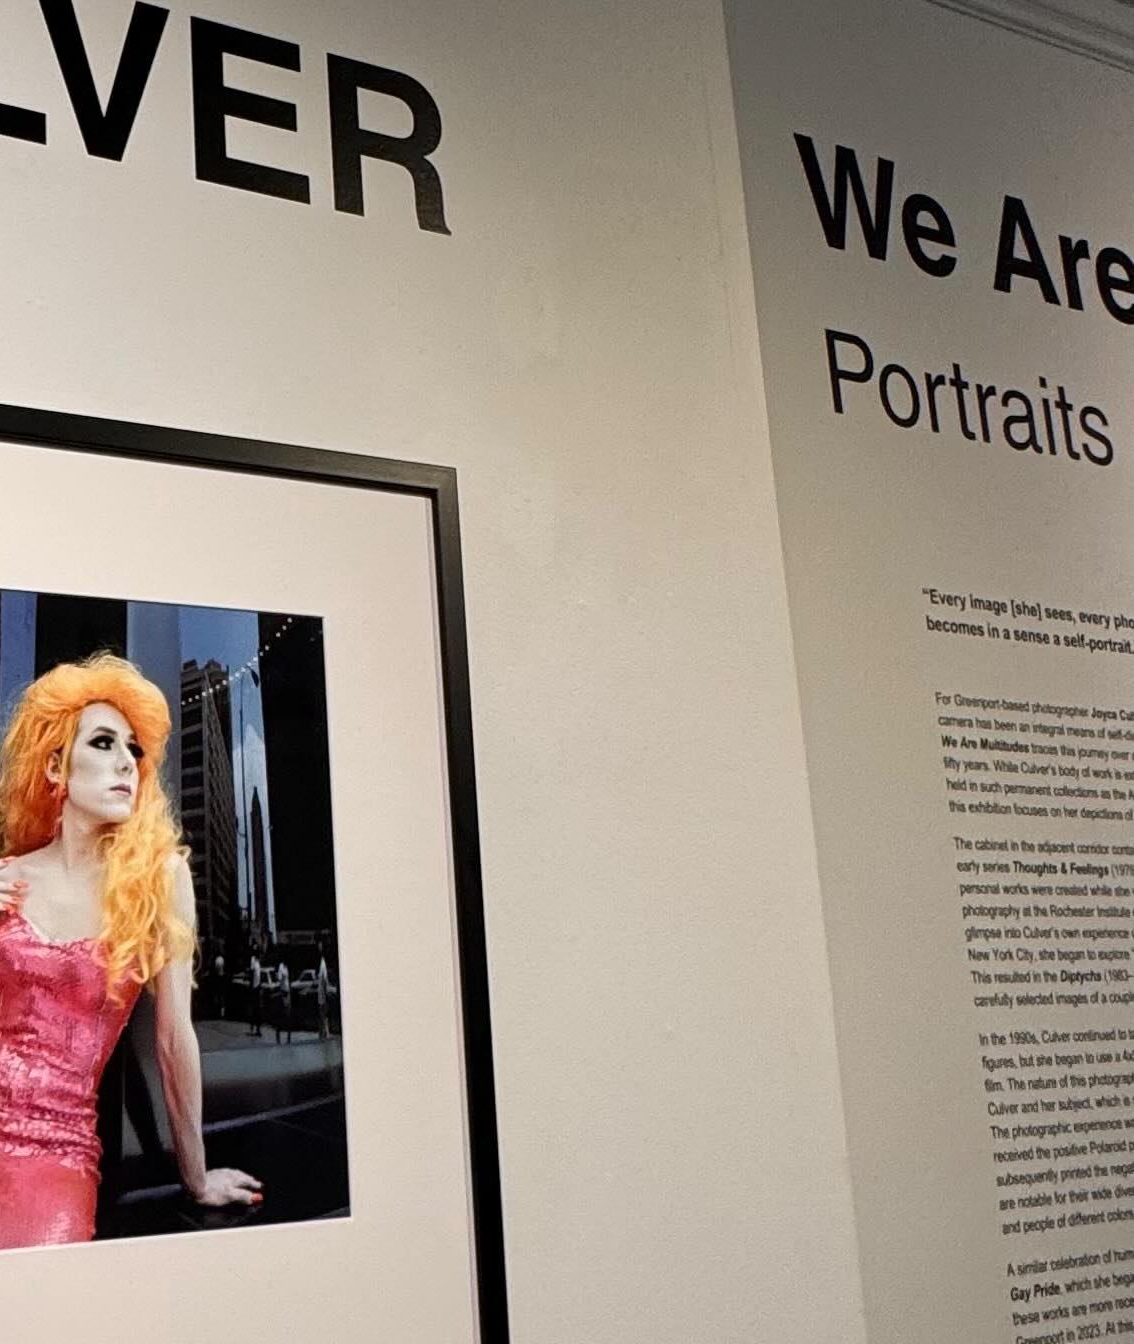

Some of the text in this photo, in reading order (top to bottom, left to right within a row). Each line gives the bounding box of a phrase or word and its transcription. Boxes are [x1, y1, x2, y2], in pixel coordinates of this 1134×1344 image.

[794, 132, 1134, 326] We Are
[824, 328, 1114, 467] Portraits
[970, 593, 1008, 616] image
[1010, 599, 1042, 621] [she]
[1044, 607, 1076, 625] sees,
[1079, 611, 1110, 630] every
[925, 615, 984, 637] becomes
[987, 623, 999, 638] in
[1003, 628, 1010, 640] a
[1013, 629, 1051, 645] sense
[1053, 634, 1061, 646] a
[935, 691, 951, 705] For
[1091, 707, 1117, 722] Joyce
[938, 716, 1105, 739] camera has been an integral means of
[941, 735, 958, 748] We
[960, 736, 977, 749] Are
[980, 737, 1030, 753] Multitudes
[1058, 764, 1080, 781] body
[1081, 765, 1090, 778] of
[1092, 767, 1112, 779] work
[945, 777, 1126, 800] held in such permanent collections as the
[968, 801, 1011, 815] exhibition
[1013, 802, 1048, 817] focuses
[1050, 807, 1061, 818] on
[1063, 805, 1078, 818] her
[953, 836, 972, 850] The
[975, 838, 1009, 851] cabinet
[1011, 841, 1019, 852] in
[1021, 840, 1035, 853] the
[1038, 840, 1075, 856] adjacent
[956, 860, 1109, 879] early series Thoughts & Feelings
[959, 883, 1131, 897] personal works were created while she
[962, 903, 1020, 920] photography
[1033, 904, 1047, 917] the
[1050, 904, 1094, 917] Rochester
[964, 926, 1002, 942] glimpse
[1082, 928, 1129, 941] experience
[968, 948, 990, 961] New
[992, 948, 1014, 962] York
[1039, 948, 1055, 961] she
[1057, 948, 1086, 964] began
[1087, 949, 1096, 960] to
[970, 969, 1101, 986] This resulted in the Diptychs
[974, 991, 1107, 1009] carefully selected images of a
[979, 1028, 1127, 1046] In the Culver continued to
[1019, 1054, 1034, 1068] but
[1036, 1054, 1053, 1067] she
[1055, 1053, 1084, 1068] began
[1085, 1052, 1094, 1064] to
[1096, 1053, 1113, 1064] use
[1007, 1077, 1026, 1090] The
[1028, 1076, 1057, 1090] nature
[1059, 1074, 1068, 1088] of
[987, 1098, 1055, 1116] Culver and her
[989, 1125, 1010, 1139] The
[1012, 1121, 1072, 1141] photographic
[993, 1146, 1033, 1163] received
[1036, 1146, 1051, 1160] the
[996, 1164, 1108, 1187] subsequently printed the
[999, 1190, 1066, 1211] are notable for
[1002, 1220, 1021, 1235] and
[1023, 1215, 1055, 1235] people
[1057, 1213, 1066, 1229] of
[1007, 1248, 1111, 1277] A celebration of
[1010, 1274, 1111, 1303] Gay which she
[1013, 1311, 1040, 1326] these
[1042, 1305, 1070, 1321] works
[1072, 1304, 1087, 1317] are
[1066, 1328, 1075, 1343] in
